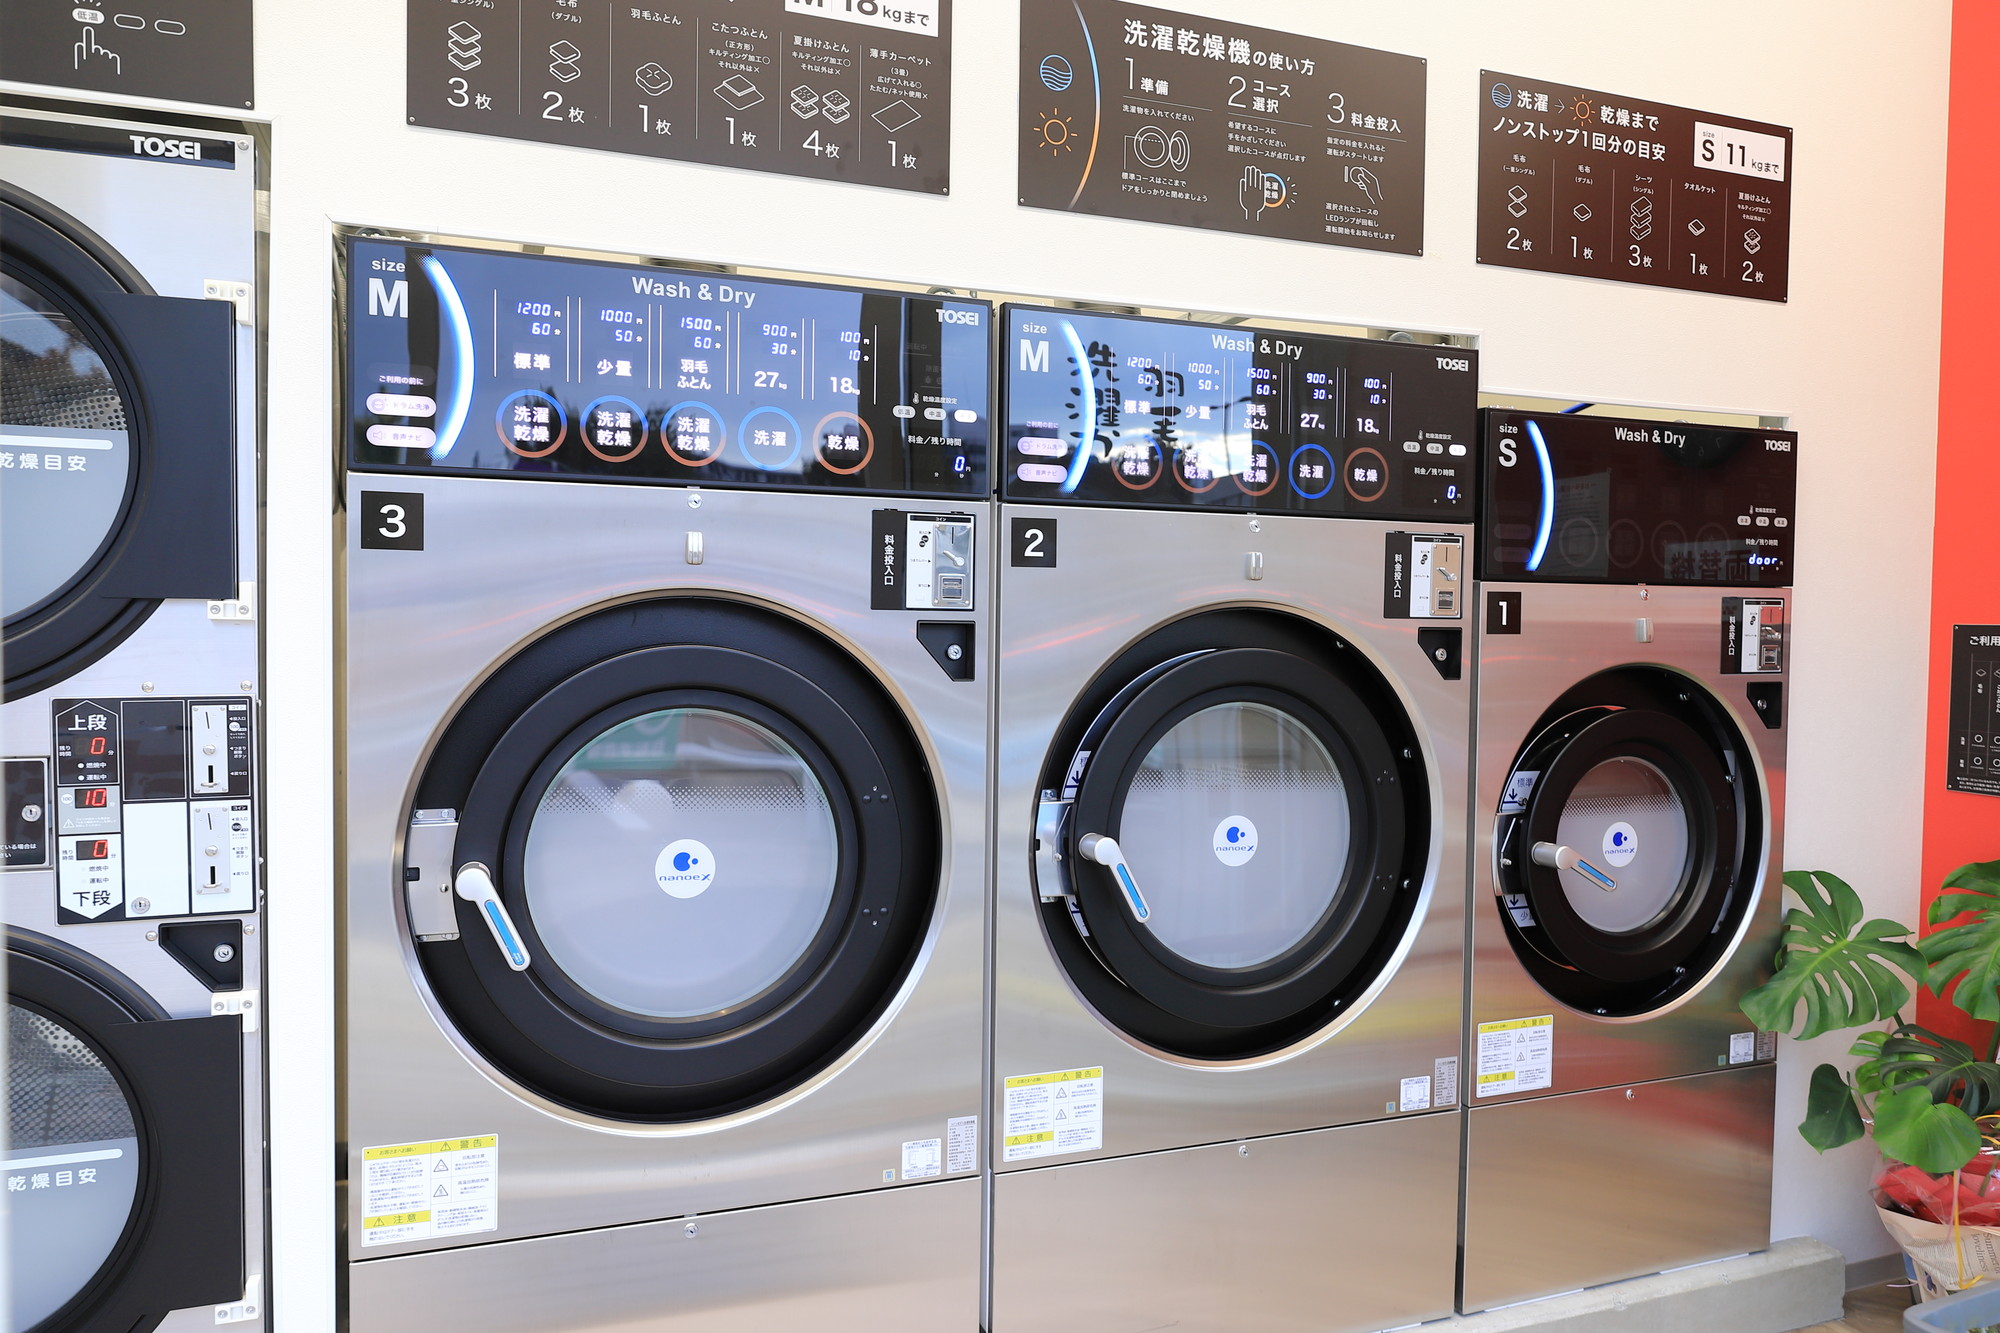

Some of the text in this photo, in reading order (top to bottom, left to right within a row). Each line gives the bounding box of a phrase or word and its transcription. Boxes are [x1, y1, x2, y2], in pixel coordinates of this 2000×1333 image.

[77, 10, 99, 22] 低温
[551, 11, 582, 24] (ダブル)
[630, 7, 682, 26] 羽毛ふとん
[711, 21, 769, 40] こたつふとん
[725, 39, 754, 52] (正方形)
[793, 34, 850, 54] 夏掛けふとん
[1123, 18, 1316, 76] 洗濯乾燥機の使い方
[869, 48, 932, 66] 薄手カーペット
[1140, 77, 1169, 96] 準備
[1252, 79, 1291, 98] コース
[1122, 104, 1195, 122] 洗濯物を入れてください
[1252, 96, 1280, 114] 選択
[1516, 89, 1660, 132] 洗濯 乾燥まで
[1227, 121, 1277, 135] 希望するコースに
[1350, 112, 1402, 133] 料金投入
[1227, 133, 1287, 148] 手をかざしてください
[1492, 116, 1667, 162] ノンストップ1回分の目安
[1702, 129, 1716, 139] size
[129, 134, 201, 161] TOSEI
[1227, 144, 1306, 163] 選択したコースが点灯します
[1326, 147, 1385, 163] 運転がスタートします
[1701, 139, 1715, 162] S
[1121, 171, 1187, 188] 標準コースはここまで
[1683, 181, 1717, 194] タオルケット
[1121, 184, 1209, 203] ドアをしっかりと閉めましょう
[371, 258, 406, 273] size
[368, 277, 409, 319] M
[631, 276, 756, 309] Wash & Dry
[935, 308, 980, 326] TOSEI
[1022, 322, 1048, 334] size
[1019, 339, 1050, 373] M
[1212, 334, 1303, 361] Wash & Dry
[513, 351, 551, 372] 標準
[596, 358, 632, 377] 少量
[680, 358, 709, 374] 羽毛
[1436, 357, 1469, 372] TOSEI
[378, 374, 424, 386] ご利用の前に
[677, 375, 712, 390] ふとん
[513, 405, 550, 424] 洗濯
[1123, 399, 1151, 415] 標準
[1185, 404, 1211, 420] 少量
[1245, 403, 1267, 417] 羽毛
[596, 410, 632, 428] 洗濯
[677, 416, 711, 434] 洗濯
[1243, 418, 1269, 431] ふとん
[513, 425, 550, 443] 乾燥
[754, 429, 787, 447] 洗濯
[1498, 423, 1518, 435] size
[1614, 427, 1685, 448] Wash & Dry
[596, 429, 632, 448] 乾燥
[677, 434, 711, 452] 乾燥
[827, 434, 860, 451] 乾燥
[1764, 439, 1791, 452] TOSEI
[0, 452, 87, 472] 乾燥目安
[1498, 438, 1518, 468] S
[1123, 460, 1150, 476] 乾燥
[1184, 464, 1209, 480] 乾燥
[1242, 470, 1268, 483] 乾燥
[1299, 464, 1324, 479] 洗濯
[1353, 467, 1378, 482] 乾燥
[378, 504, 407, 538] 3
[1023, 528, 1044, 557] 2
[884, 534, 894, 586] 料金投入口
[1393, 553, 1403, 599] 料金投入口
[1498, 601, 1507, 626] 1
[1728, 616, 1736, 655] 料金投入口
[68, 714, 107, 731] 上段
[1517, 777, 1534, 788] 標準
[73, 890, 111, 907] 下段
[7, 1167, 97, 1193] 乾燥目安
[1971, 1233, 1989, 1272] loveliness
[1983, 1232, 1999, 1266] Summer
